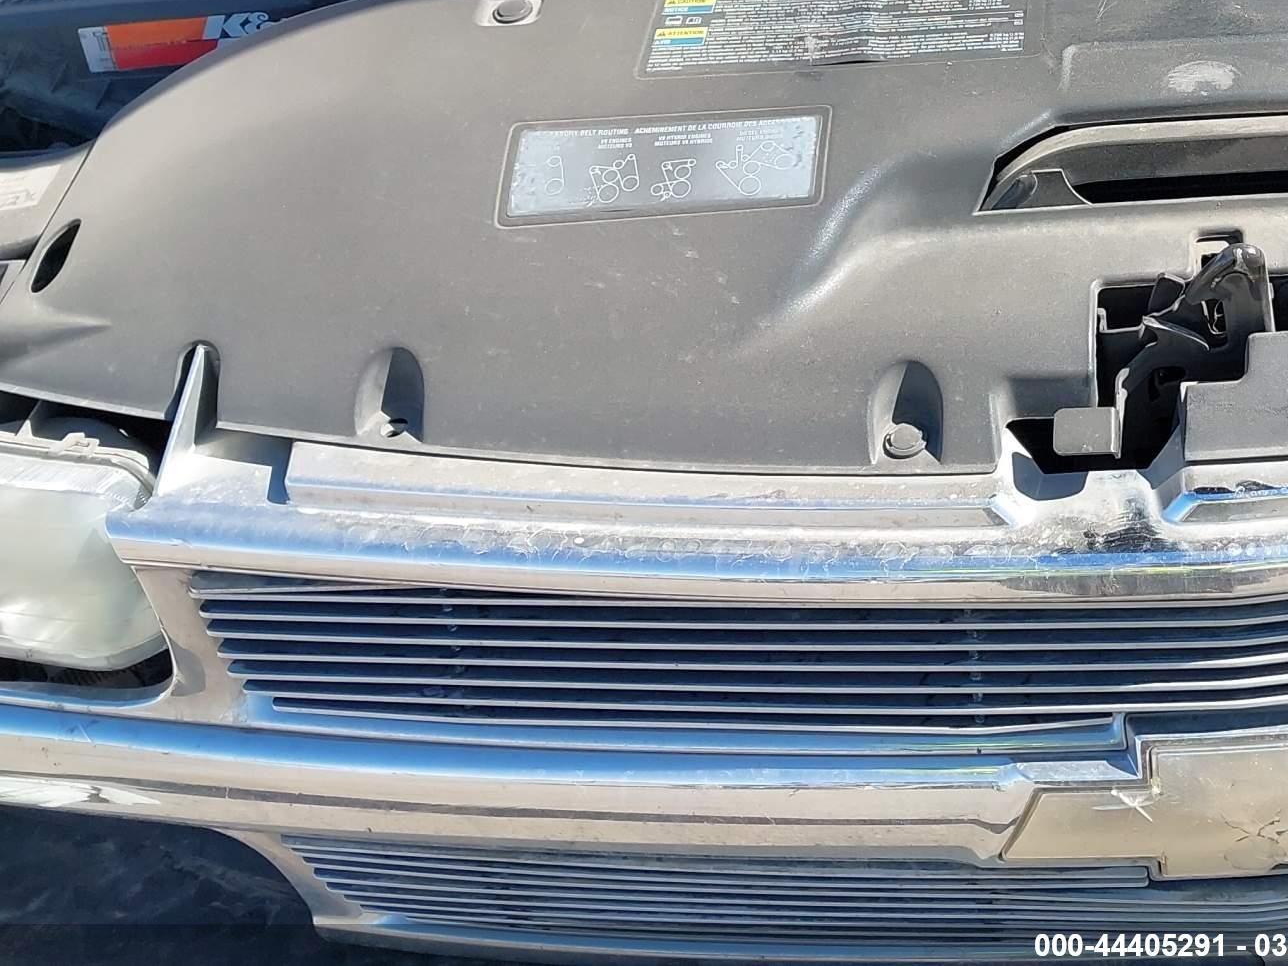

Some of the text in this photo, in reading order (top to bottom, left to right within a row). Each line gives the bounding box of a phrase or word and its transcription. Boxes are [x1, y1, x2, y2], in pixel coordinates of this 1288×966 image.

[202, 11, 284, 40] K&
[579, 129, 597, 137] BELT
[598, 128, 629, 136] ROUTING
